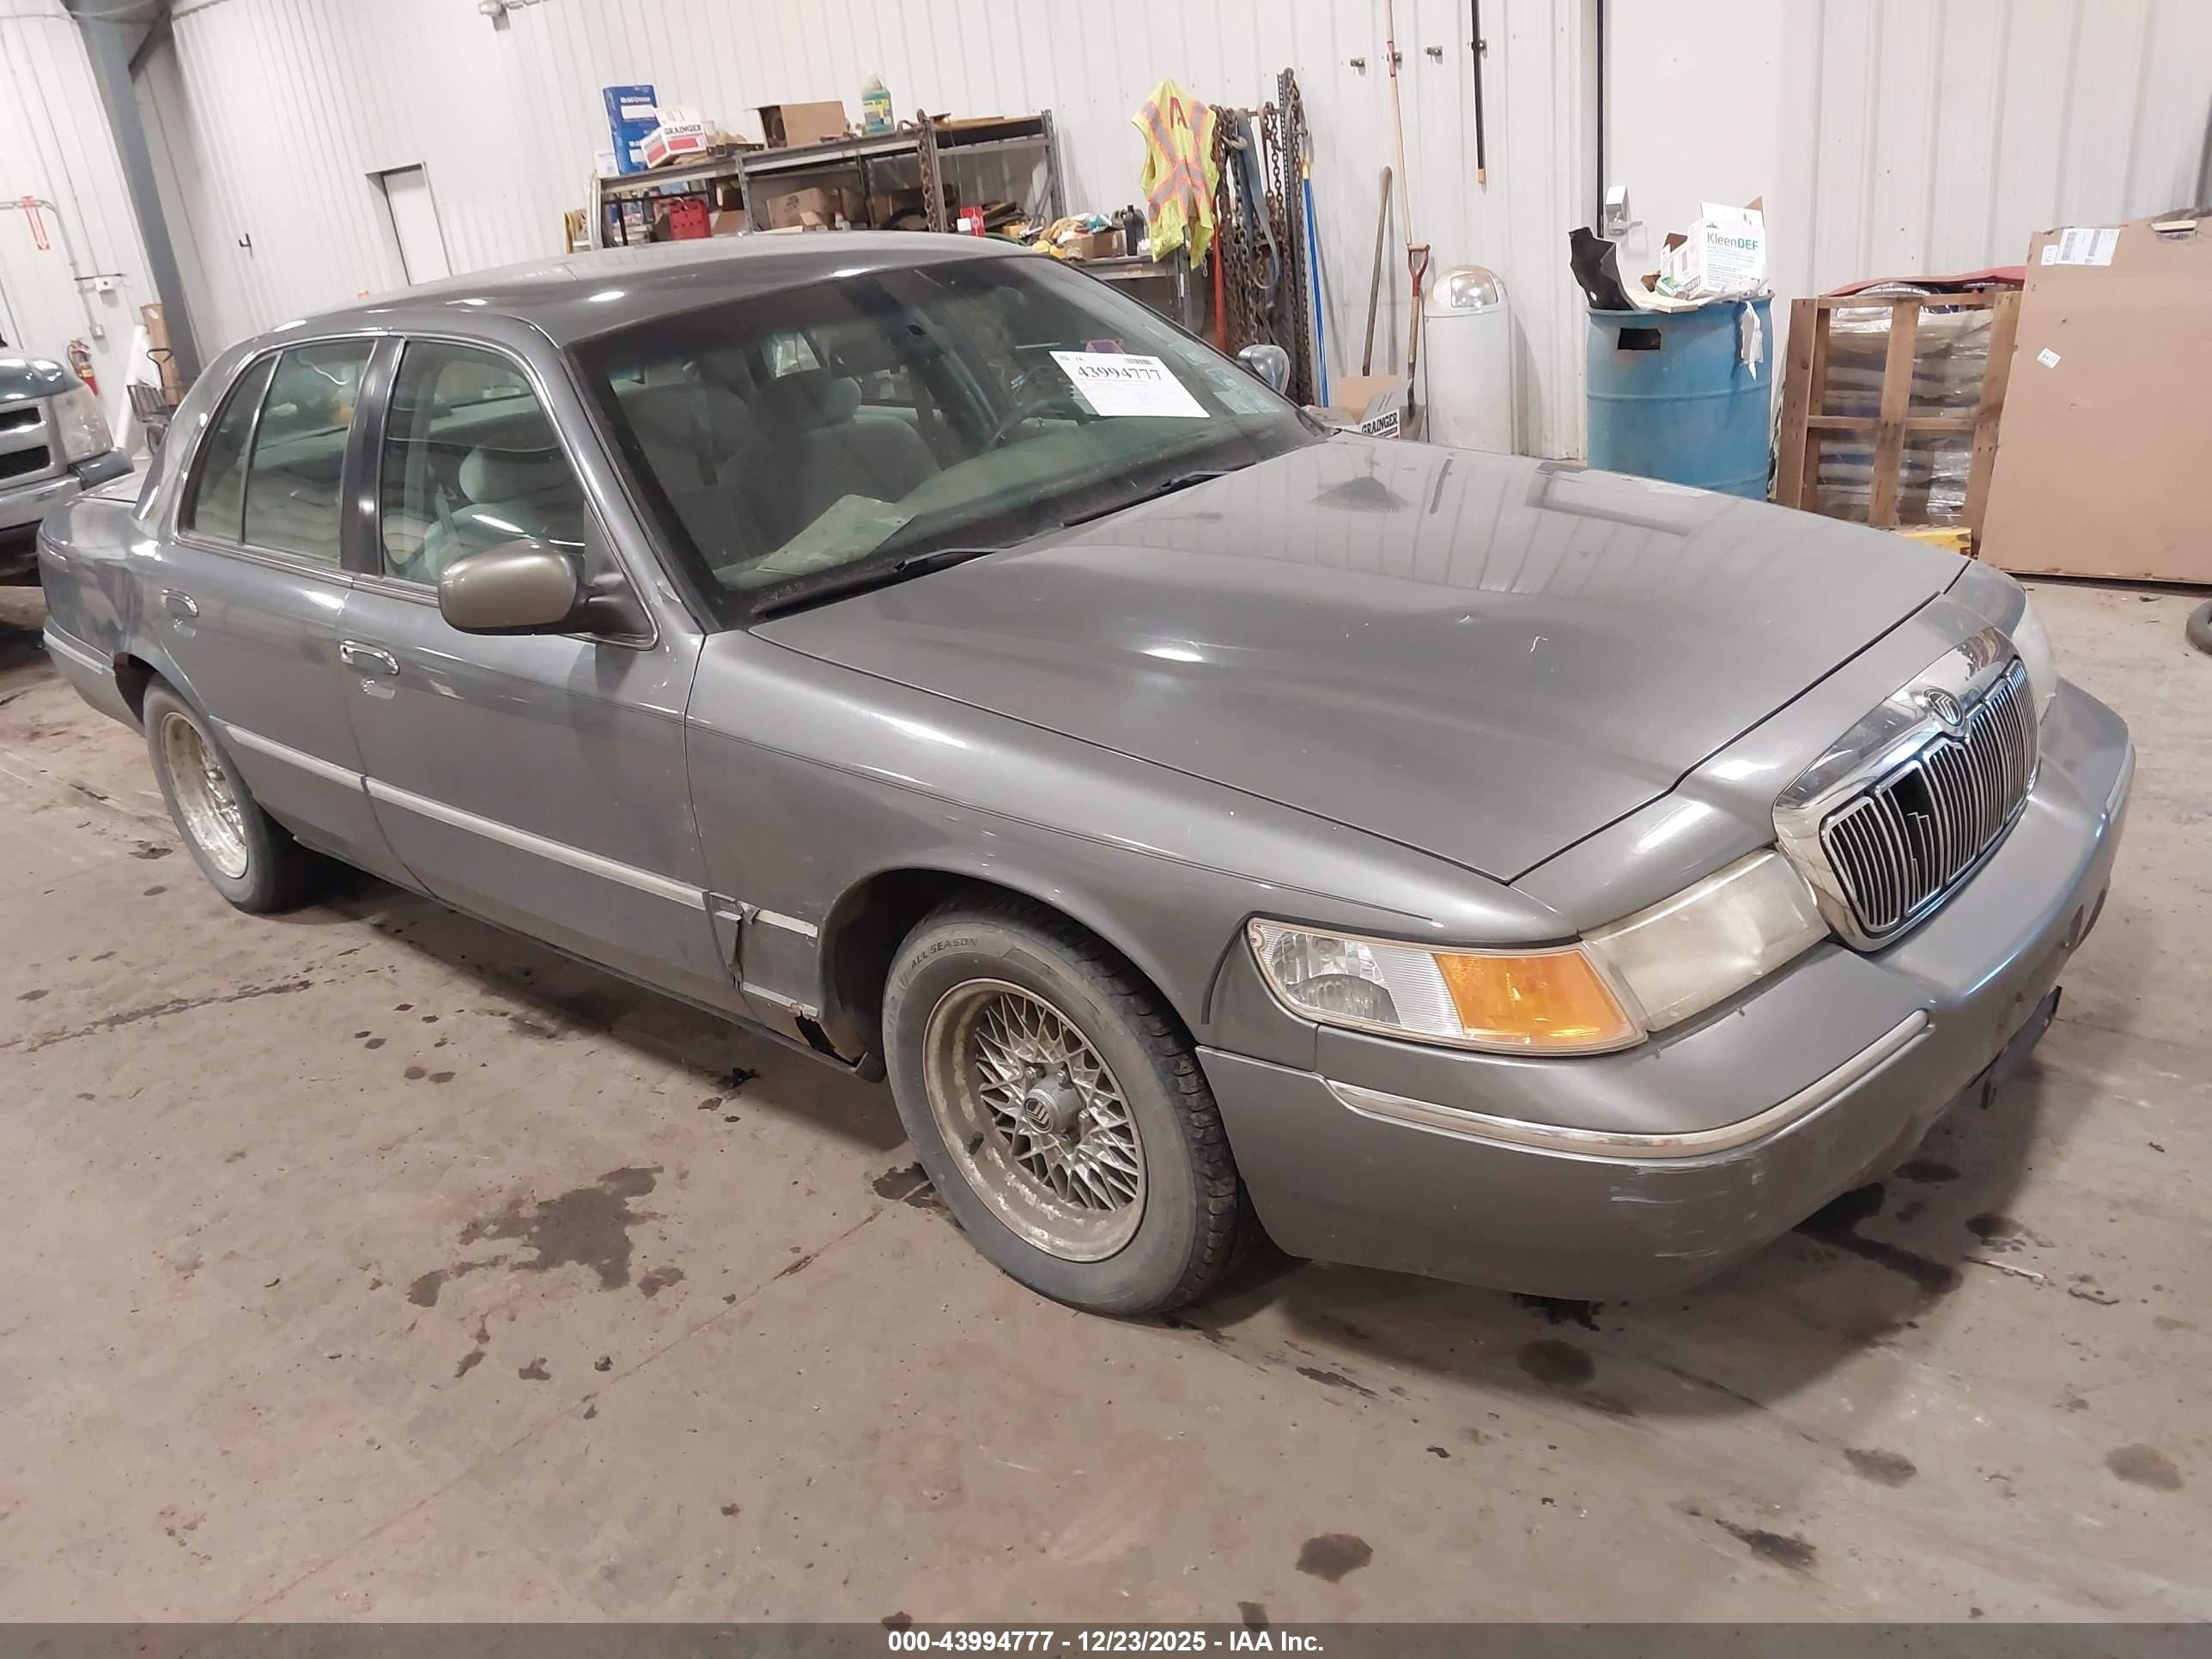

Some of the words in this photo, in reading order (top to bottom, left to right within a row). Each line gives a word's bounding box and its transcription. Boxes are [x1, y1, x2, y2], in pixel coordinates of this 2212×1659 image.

[664, 124, 702, 136] GRAINGER
[1706, 232, 1759, 252] KleenDEF
[1078, 365, 1162, 381] 43994777
[1361, 411, 1399, 434] GRAINGER
[910, 950, 929, 969] ALL
[930, 937, 979, 955] SEASON
